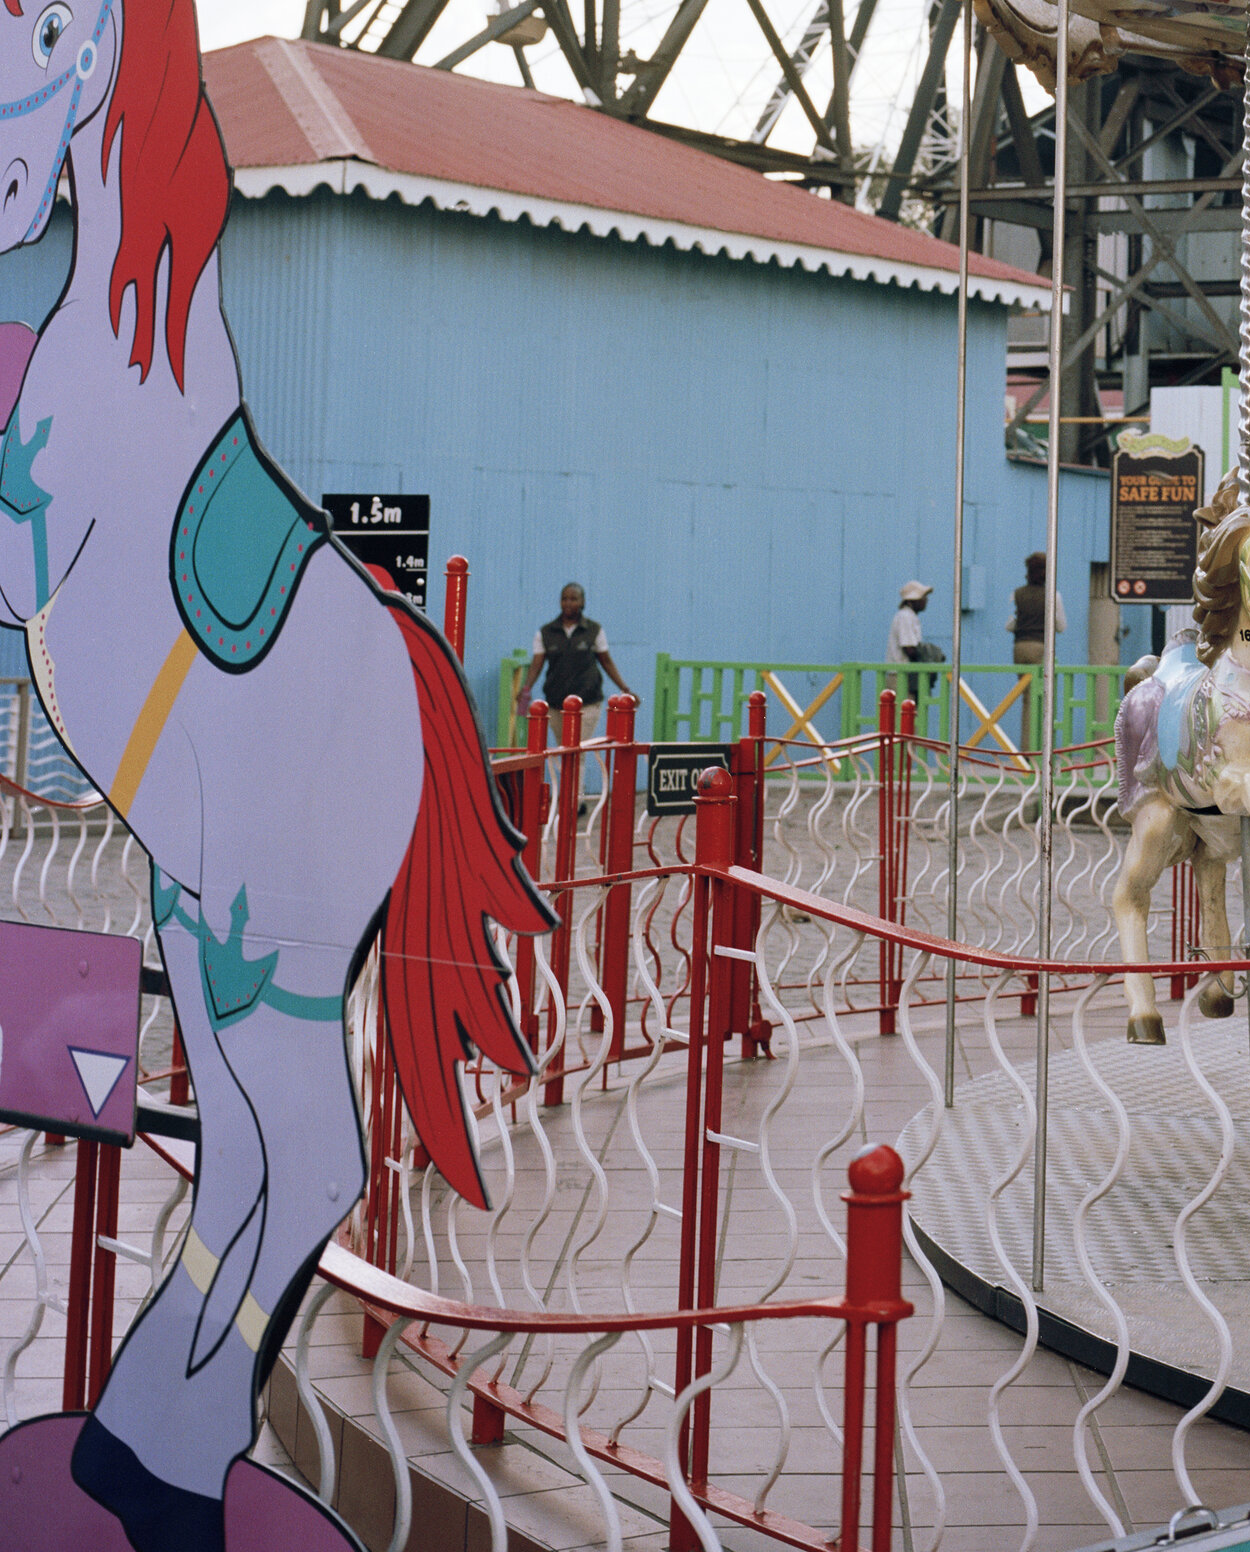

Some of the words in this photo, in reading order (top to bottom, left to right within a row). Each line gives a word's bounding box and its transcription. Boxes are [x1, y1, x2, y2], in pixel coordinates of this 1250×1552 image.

[1119, 475, 1147, 486] YOUR
[1181, 475, 1196, 486] TO
[1119, 486, 1159, 502] SAFE
[1161, 486, 1196, 502] FUN
[350, 501, 402, 524] 1.5m
[395, 555, 424, 568] 1.4m
[659, 768, 688, 791] EXIT
